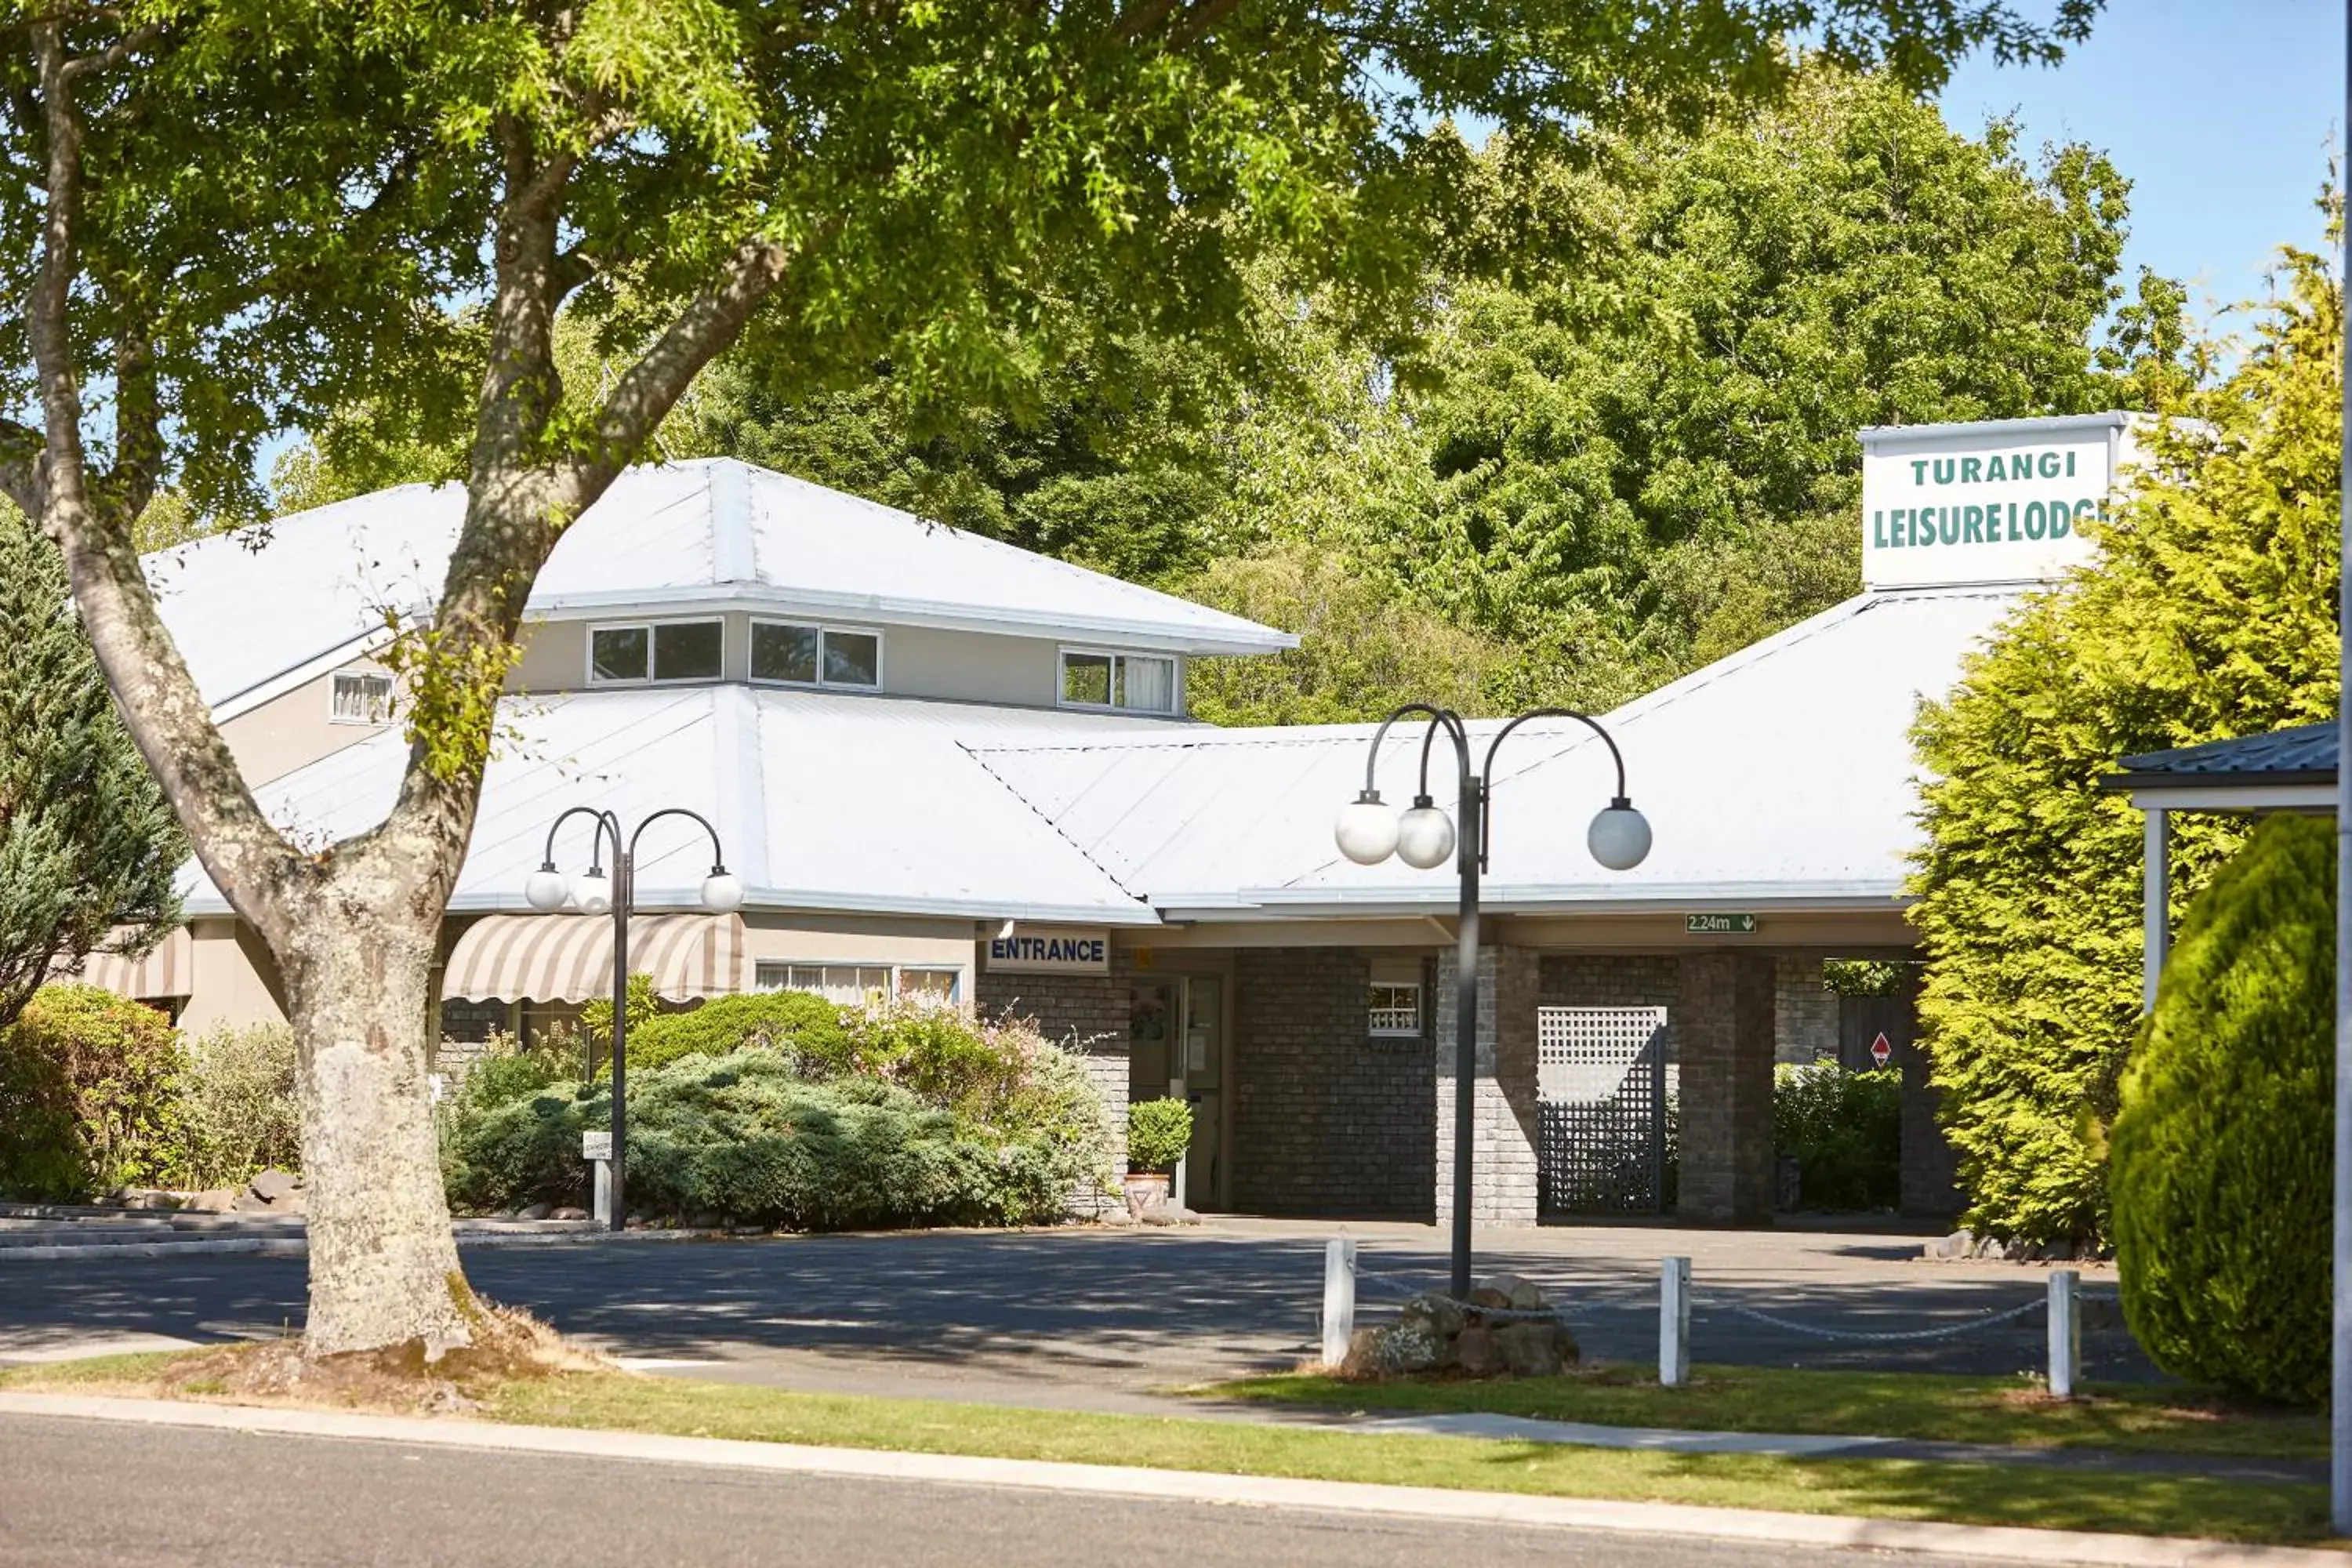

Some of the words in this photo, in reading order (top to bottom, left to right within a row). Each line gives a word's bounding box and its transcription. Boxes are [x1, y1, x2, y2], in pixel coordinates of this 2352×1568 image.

[1911, 452, 2076, 485] TURANGI
[1875, 503, 2001, 549] LEISURE
[2008, 499, 2110, 541] LODG
[1689, 915, 1730, 931] 2.24m
[992, 938, 1104, 962] ENTRANCE
